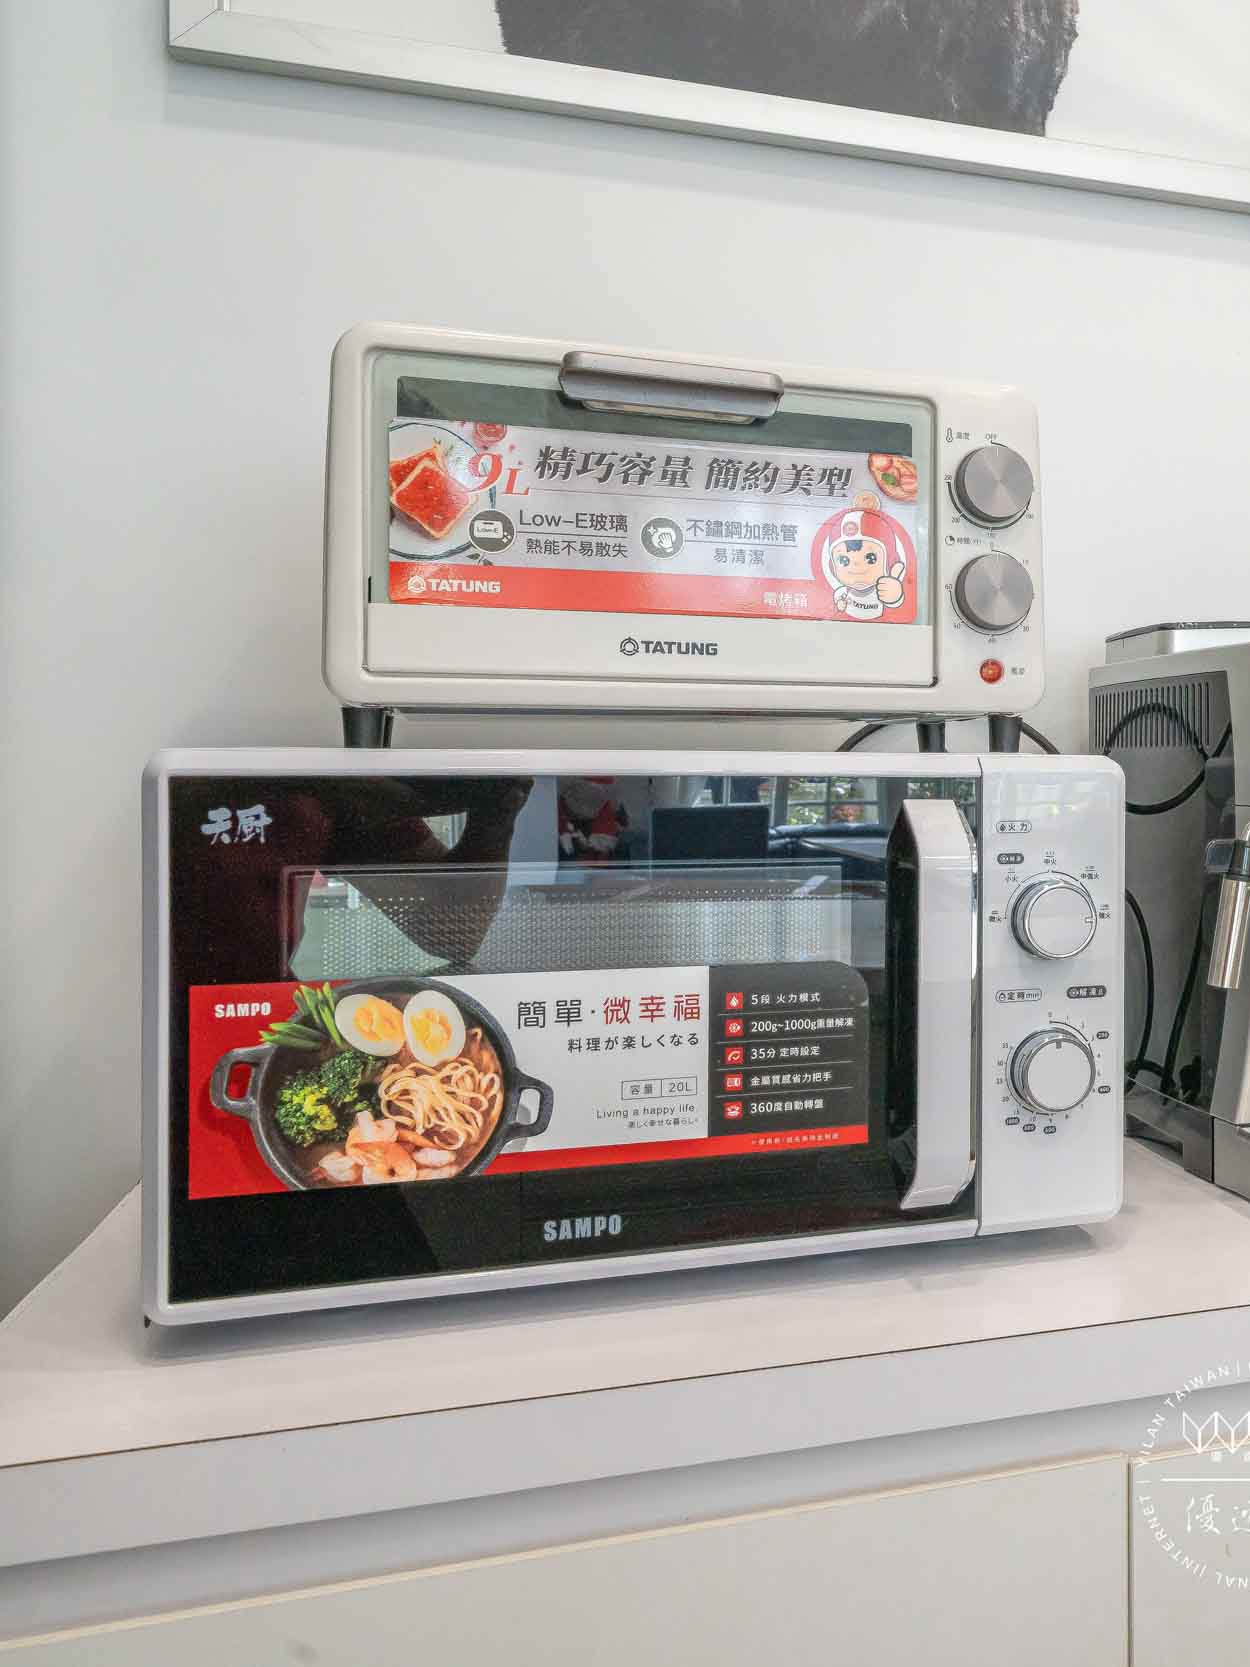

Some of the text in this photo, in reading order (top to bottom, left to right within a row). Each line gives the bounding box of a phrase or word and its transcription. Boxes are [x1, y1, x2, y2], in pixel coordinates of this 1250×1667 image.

[534, 446, 695, 489] 精巧容量
[705, 456, 853, 498] 簡約美型
[526, 538, 628, 559] 熱能不易散失
[713, 549, 765, 565] 易清潔
[428, 578, 501, 593] TATUNG
[641, 639, 718, 656] TATUNG
[215, 1002, 271, 1018] SAMPO
[568, 1033, 699, 1053] 料理が楽しくなる
[751, 1047, 776, 1060] 35分
[669, 1081, 692, 1093] 20L
[597, 1108, 629, 1119] Living
[643, 1104, 675, 1117] happy
[679, 1103, 695, 1113] life
[543, 1214, 622, 1241] SAMPO
